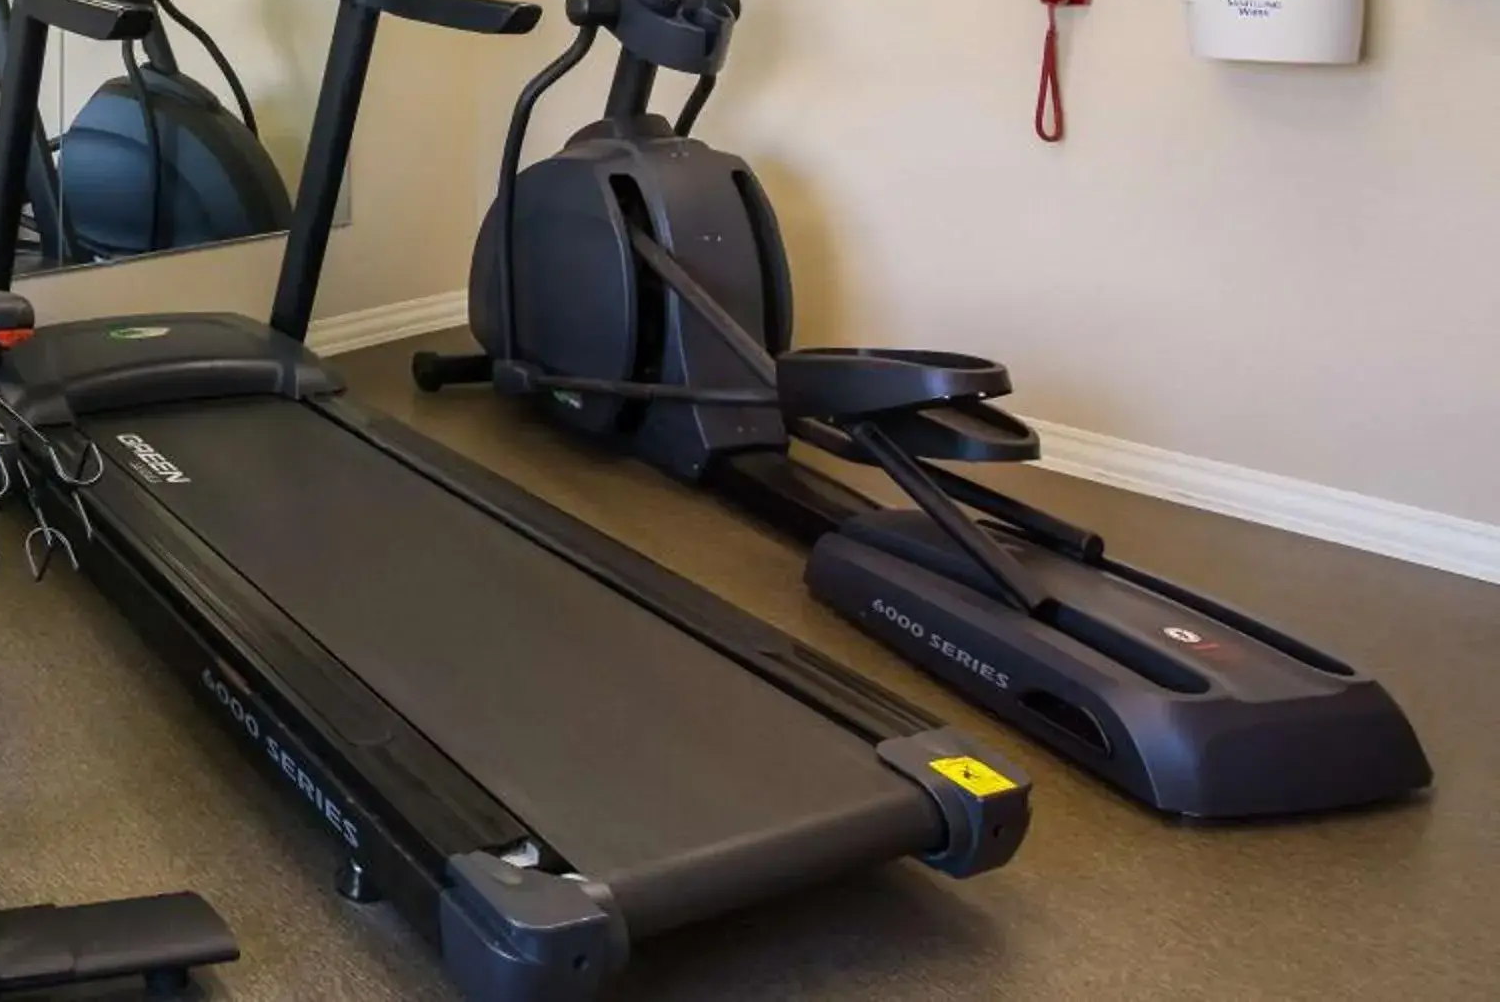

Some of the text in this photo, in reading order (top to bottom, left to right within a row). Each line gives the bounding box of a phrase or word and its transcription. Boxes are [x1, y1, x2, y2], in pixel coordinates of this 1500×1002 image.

[116, 433, 191, 483] GREEN
[872, 598, 1010, 690] 6000 SERIES
[266, 734, 359, 849] SERIES
